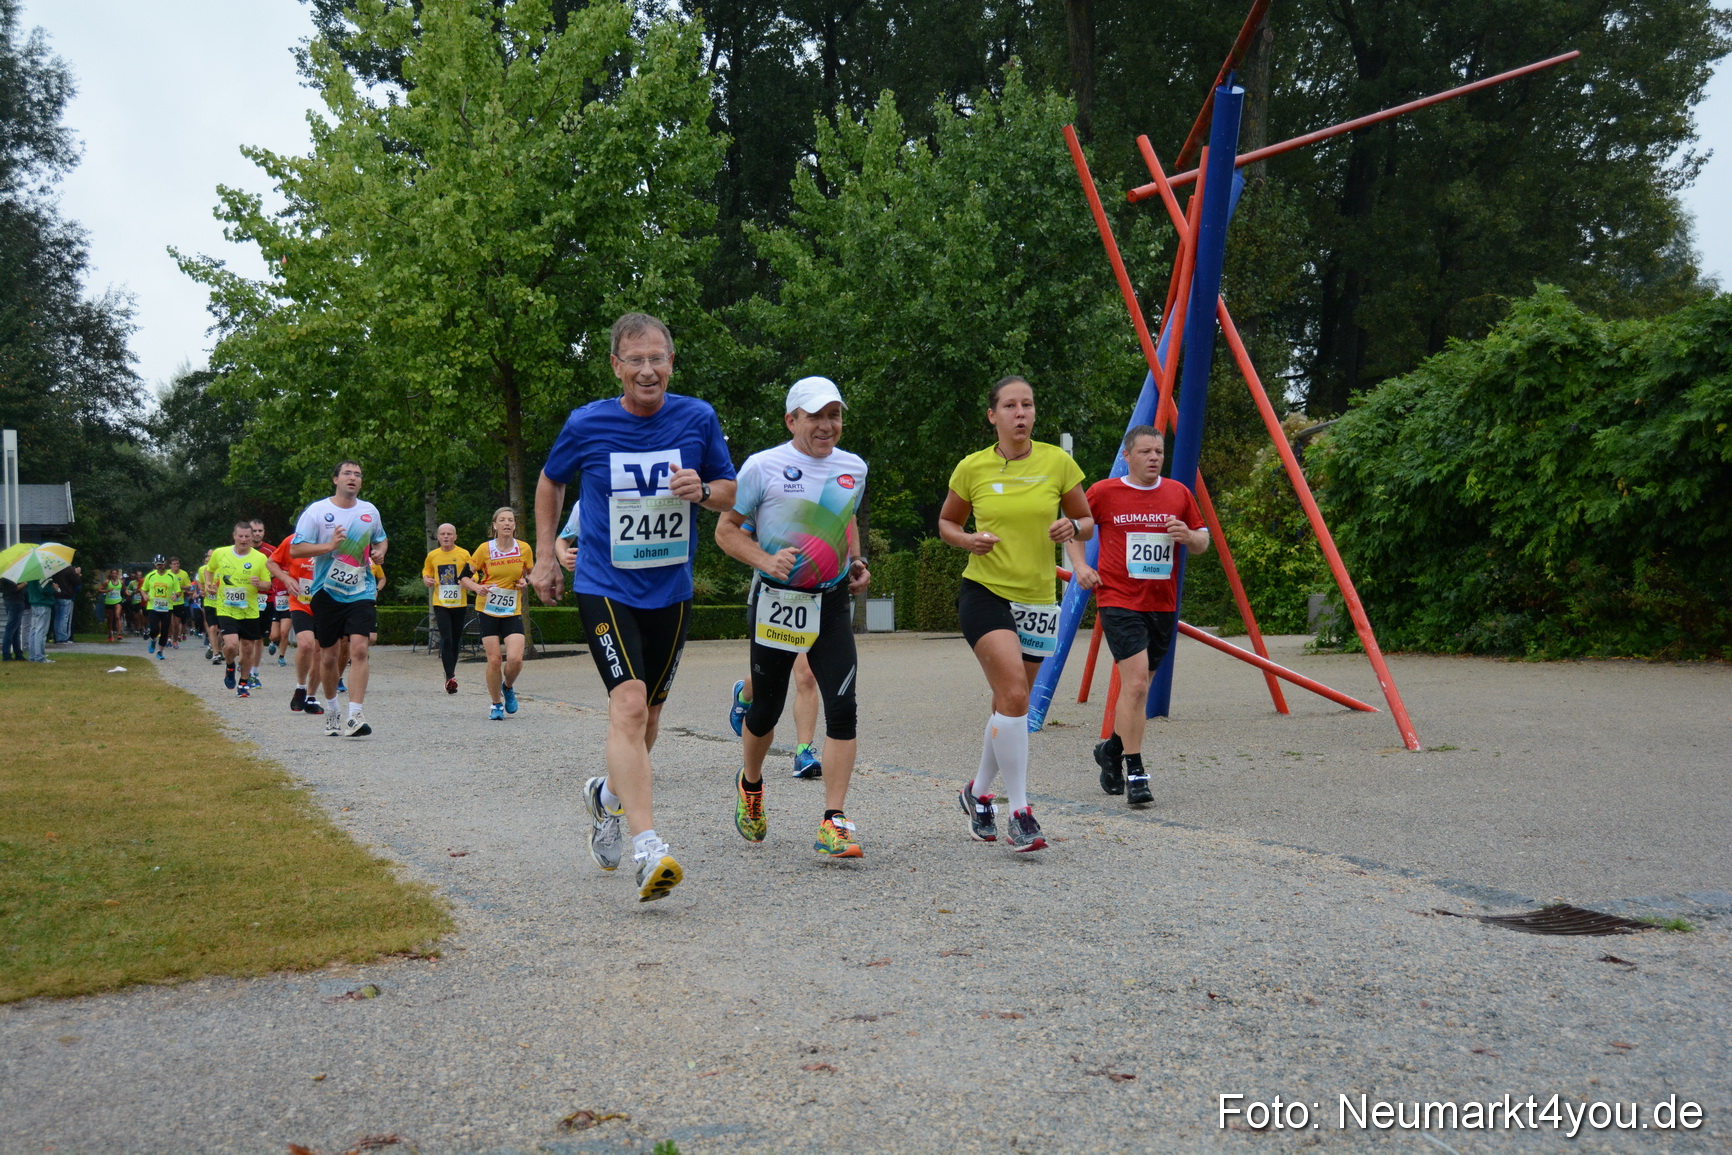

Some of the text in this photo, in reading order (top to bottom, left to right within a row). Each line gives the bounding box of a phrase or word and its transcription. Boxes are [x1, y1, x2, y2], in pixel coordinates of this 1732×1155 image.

[646, 498, 682, 508] BOCK
[620, 512, 684, 540] 2442
[1113, 513, 1168, 524] NEUMARKT
[633, 548, 669, 559] Johann
[1132, 544, 1170, 562] 2604
[330, 568, 359, 585] 2323
[443, 590, 458, 598] 226
[490, 594, 514, 606] 2755
[769, 601, 807, 630] 220
[1014, 610, 1058, 634] 2354
[766, 628, 806, 646] Christoph
[600, 633, 624, 678] SKINS
